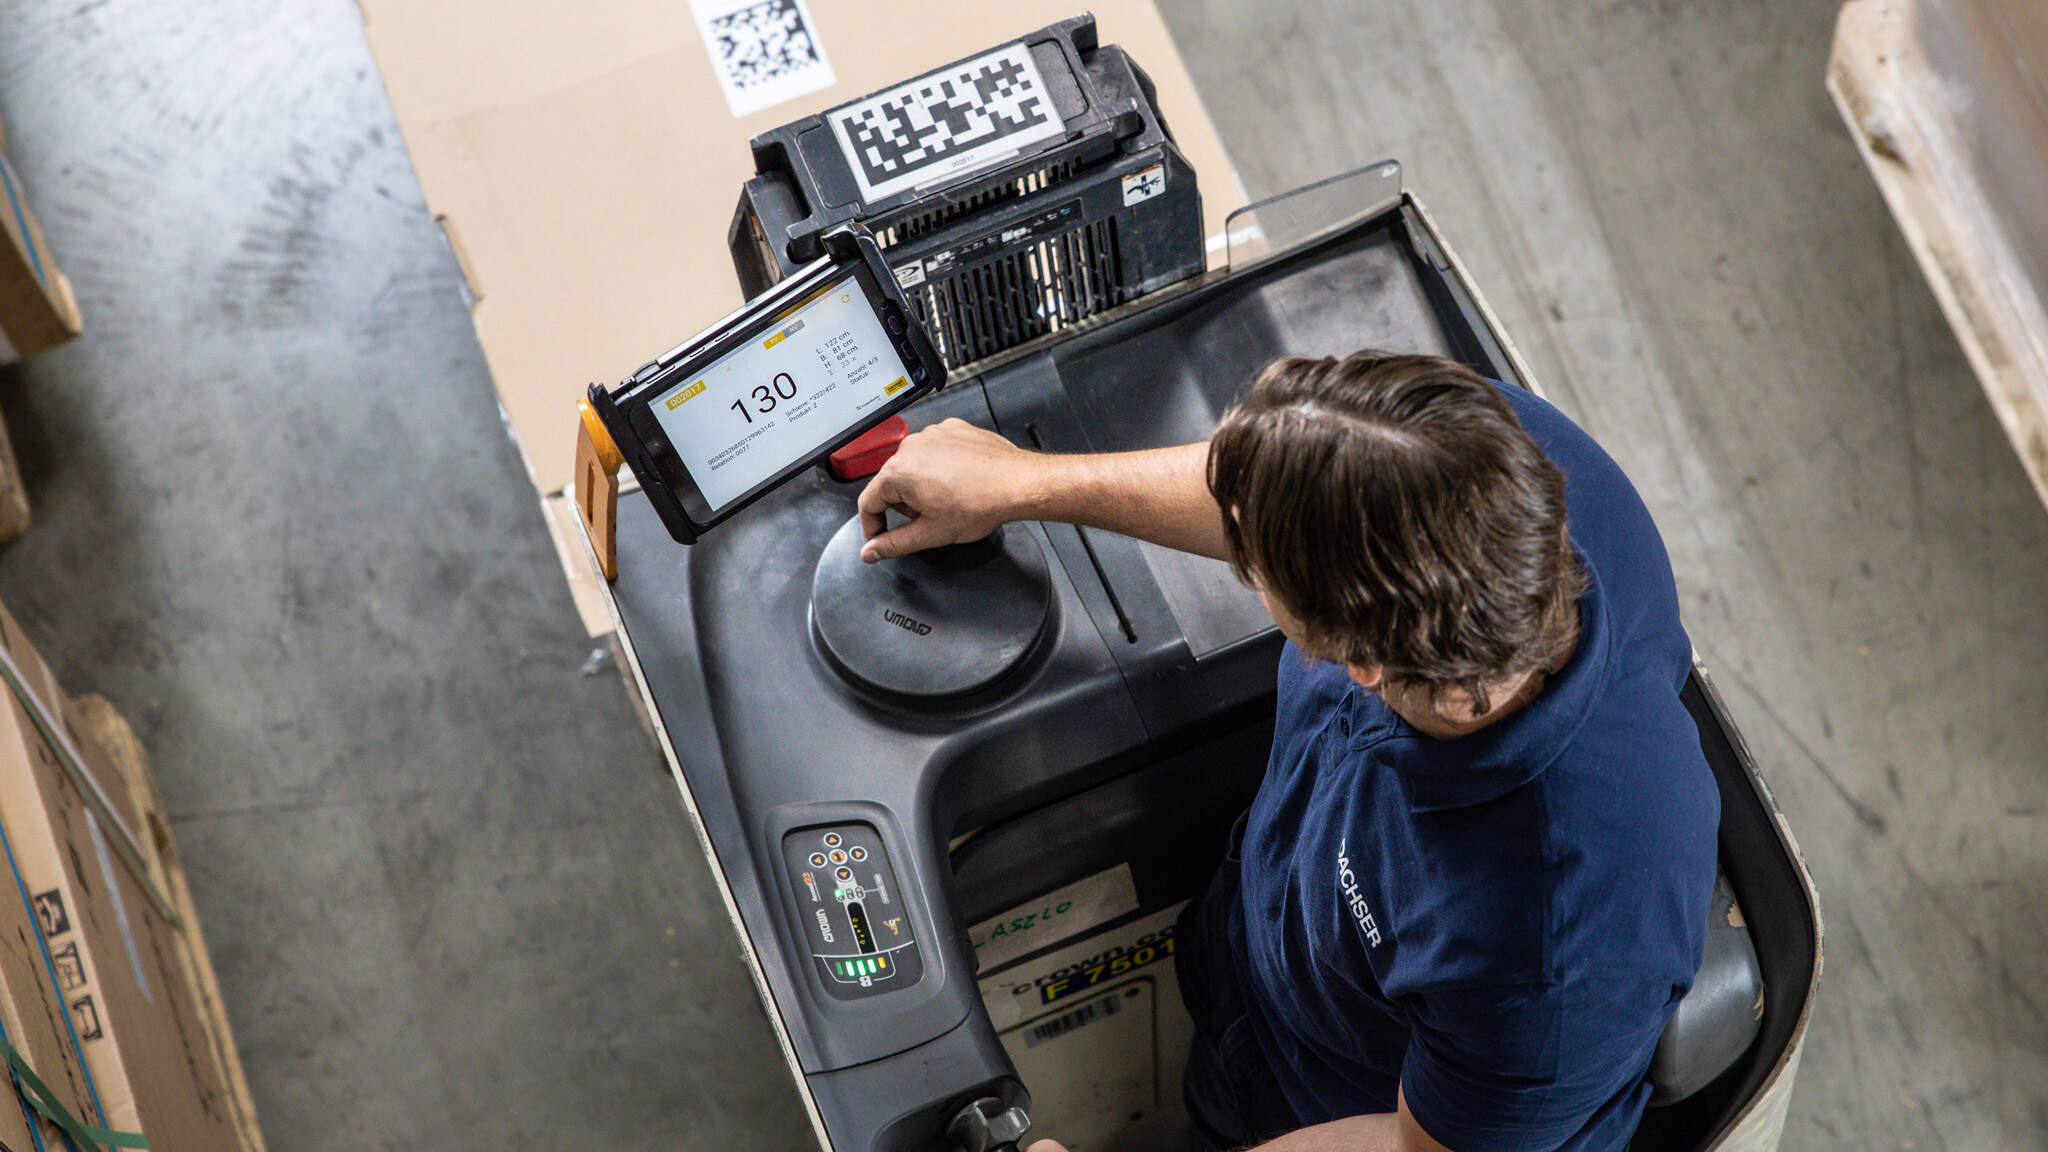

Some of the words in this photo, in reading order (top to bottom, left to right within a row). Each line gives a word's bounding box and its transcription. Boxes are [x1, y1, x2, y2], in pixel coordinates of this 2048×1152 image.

[825, 337, 839, 348] 122
[839, 331, 850, 341] cm
[833, 345, 842, 354] 81
[843, 338, 854, 348] cm
[837, 352, 846, 361] 68
[847, 345, 858, 355] cm
[670, 384, 701, 407] 002017
[731, 372, 797, 424] 130
[1046, 979, 1069, 1000] F
